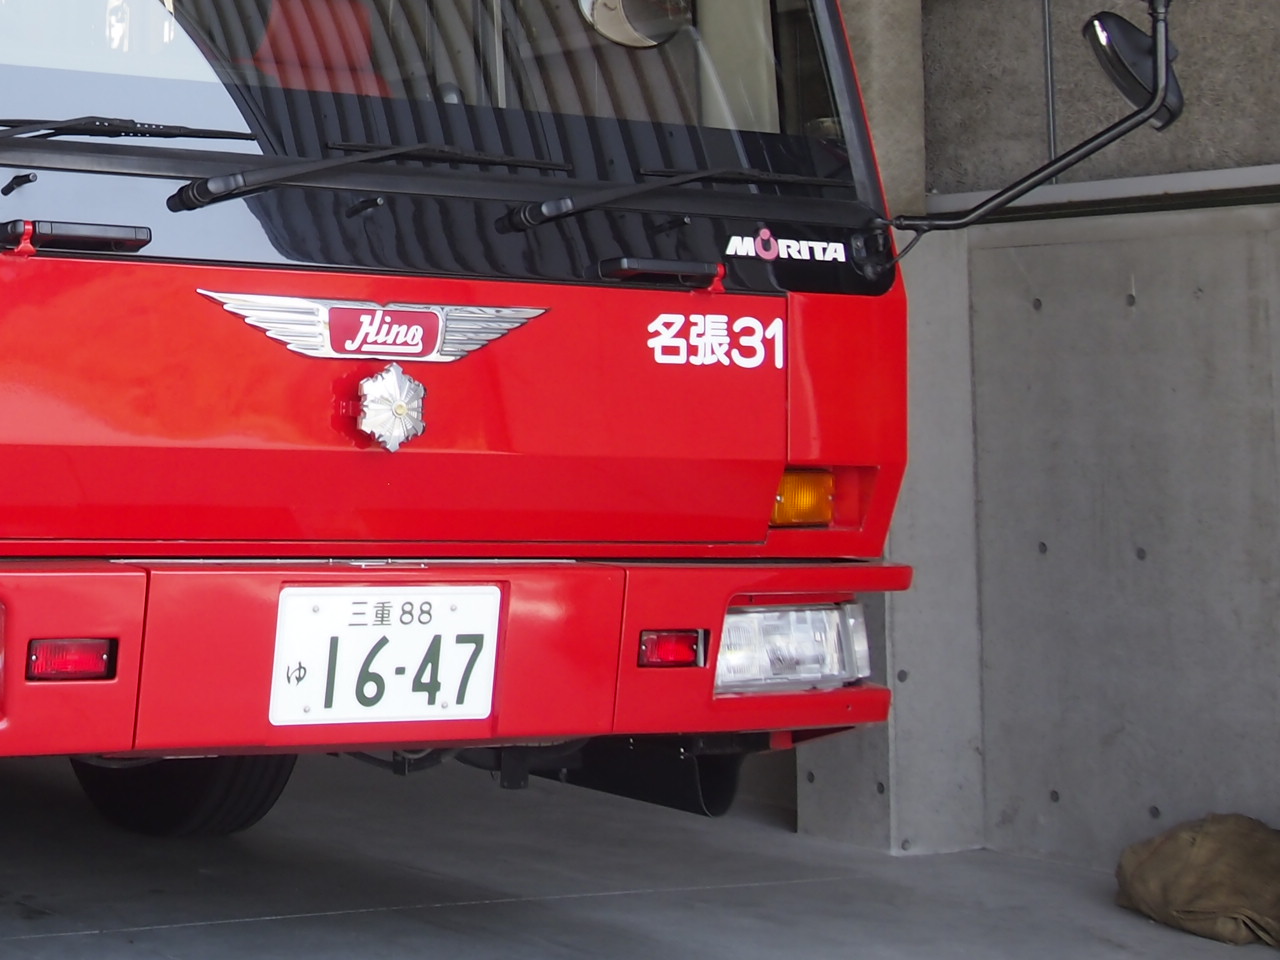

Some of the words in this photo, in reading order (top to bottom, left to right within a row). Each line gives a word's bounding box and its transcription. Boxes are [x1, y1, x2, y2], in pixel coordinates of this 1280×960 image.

[726, 227, 847, 263] MORITA
[344, 309, 424, 354] Hino
[646, 313, 784, 370] 名張31
[286, 660, 308, 687] ゆ
[323, 633, 485, 709] 16-47
